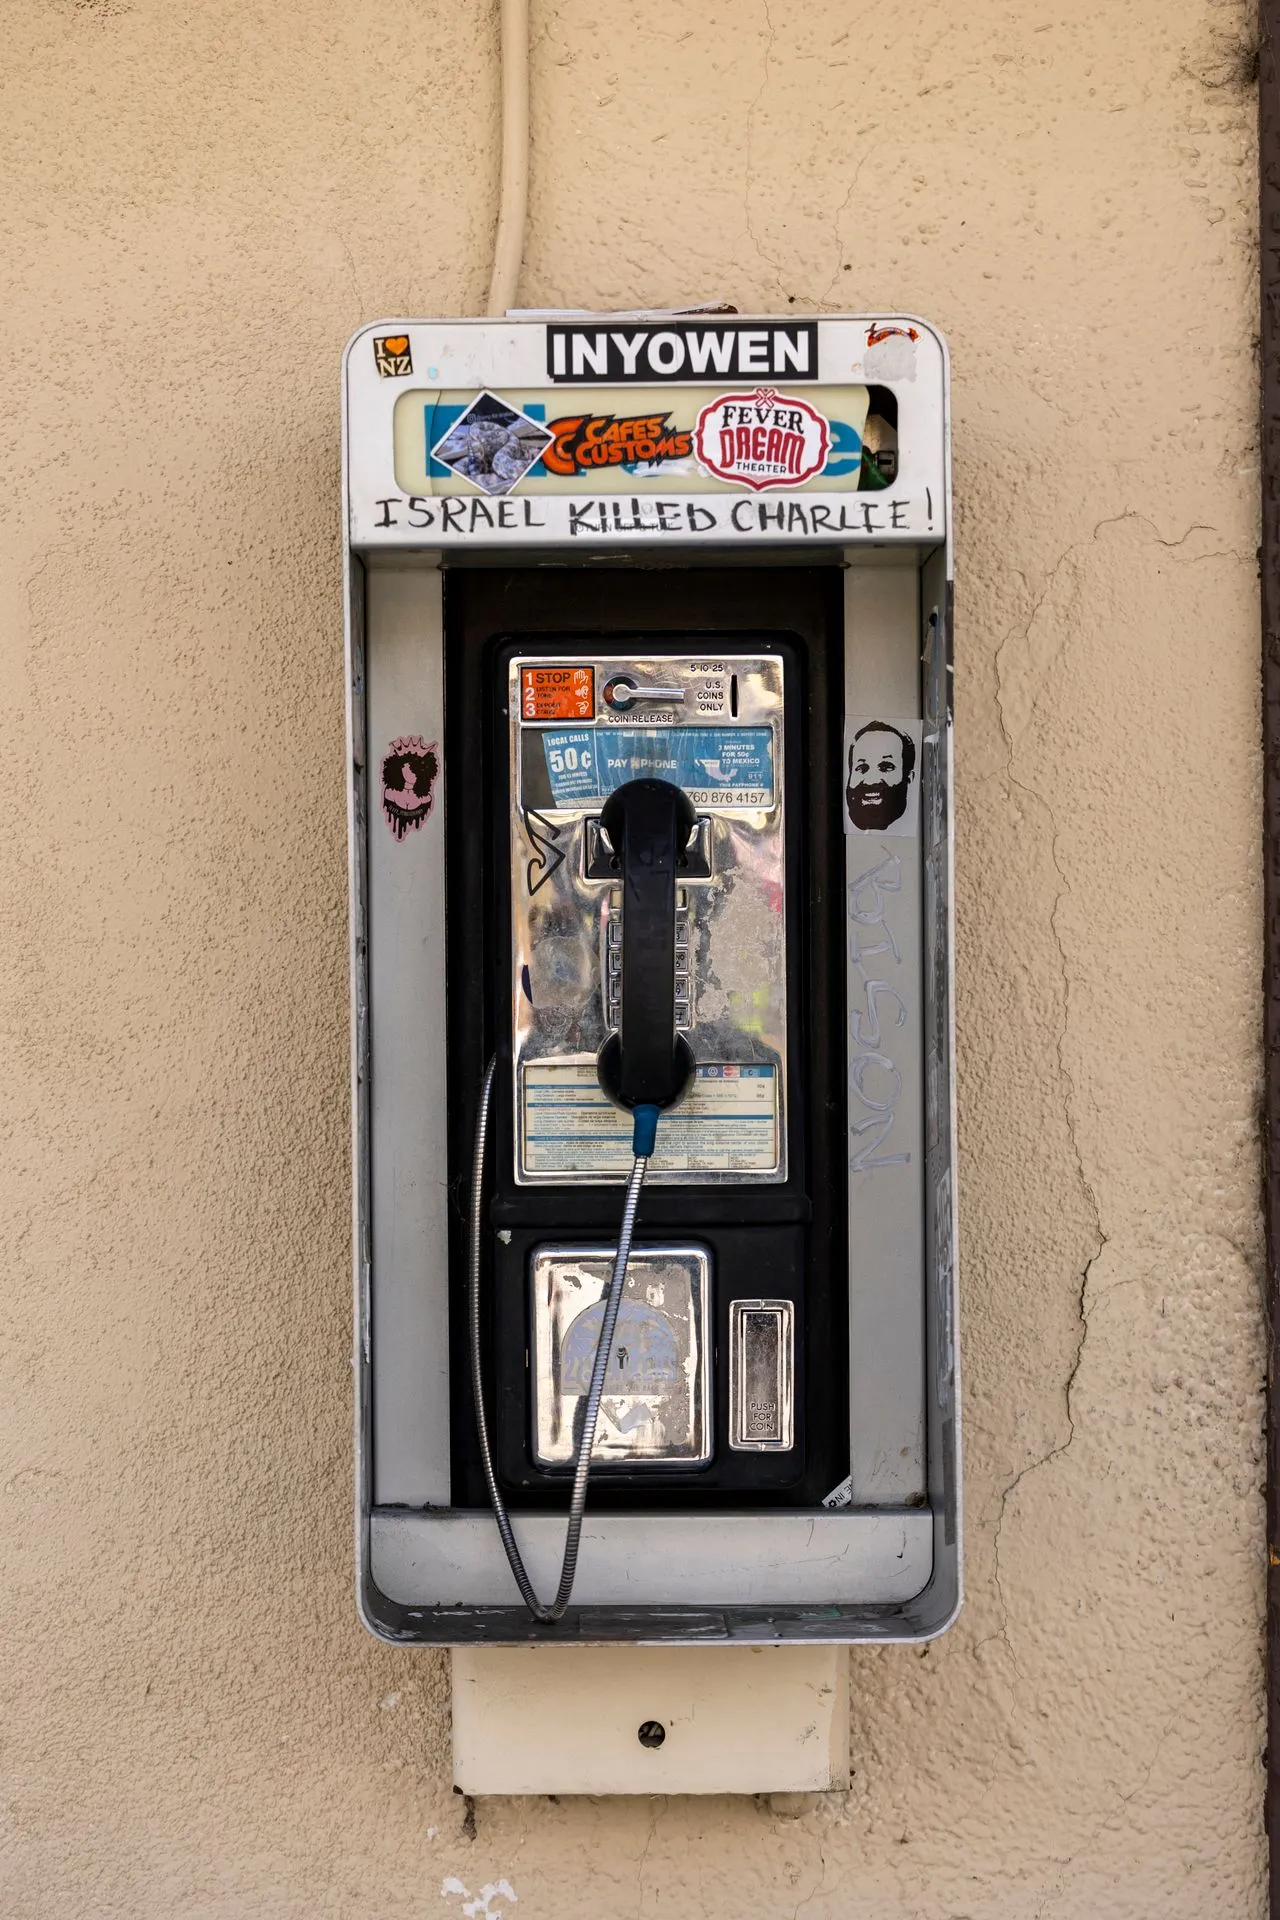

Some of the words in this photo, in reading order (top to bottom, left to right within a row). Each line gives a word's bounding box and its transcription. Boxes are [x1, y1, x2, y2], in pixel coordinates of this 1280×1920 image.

[375, 339, 386, 357] I
[553, 331, 809, 374] INYOWEN
[377, 356, 411, 378] NZ
[721, 405, 804, 434] FEVER
[584, 416, 665, 443] CAFES
[575, 434, 691, 466] CUSTOMS
[719, 427, 805, 474] DREAM
[736, 461, 787, 473] THEATER
[374, 496, 546, 533] ISRAEL
[569, 497, 717, 536] KILLED
[526, 672, 533, 686] 1
[536, 672, 571, 684] STOP
[705, 681, 724, 689] U.S.
[525, 687, 536, 701] 2
[697, 692, 724, 700] COINS
[525, 703, 536, 717] 3
[700, 703, 724, 711] ONLY
[608, 714, 629, 723] COIN
[632, 714, 673, 723] RELEASE
[547, 737, 568, 746] LOCAL
[569, 733, 590, 743] CALLS
[607, 758, 628, 768] PAY
[641, 759, 677, 769] PHONE
[687, 791, 708, 803] 760
[711, 792, 733, 803] 876
[736, 792, 765, 804] 4157
[750, 1402, 776, 1411] PUSH
[753, 1412, 772, 1421] FOR
[750, 1422, 774, 1431] COIN
